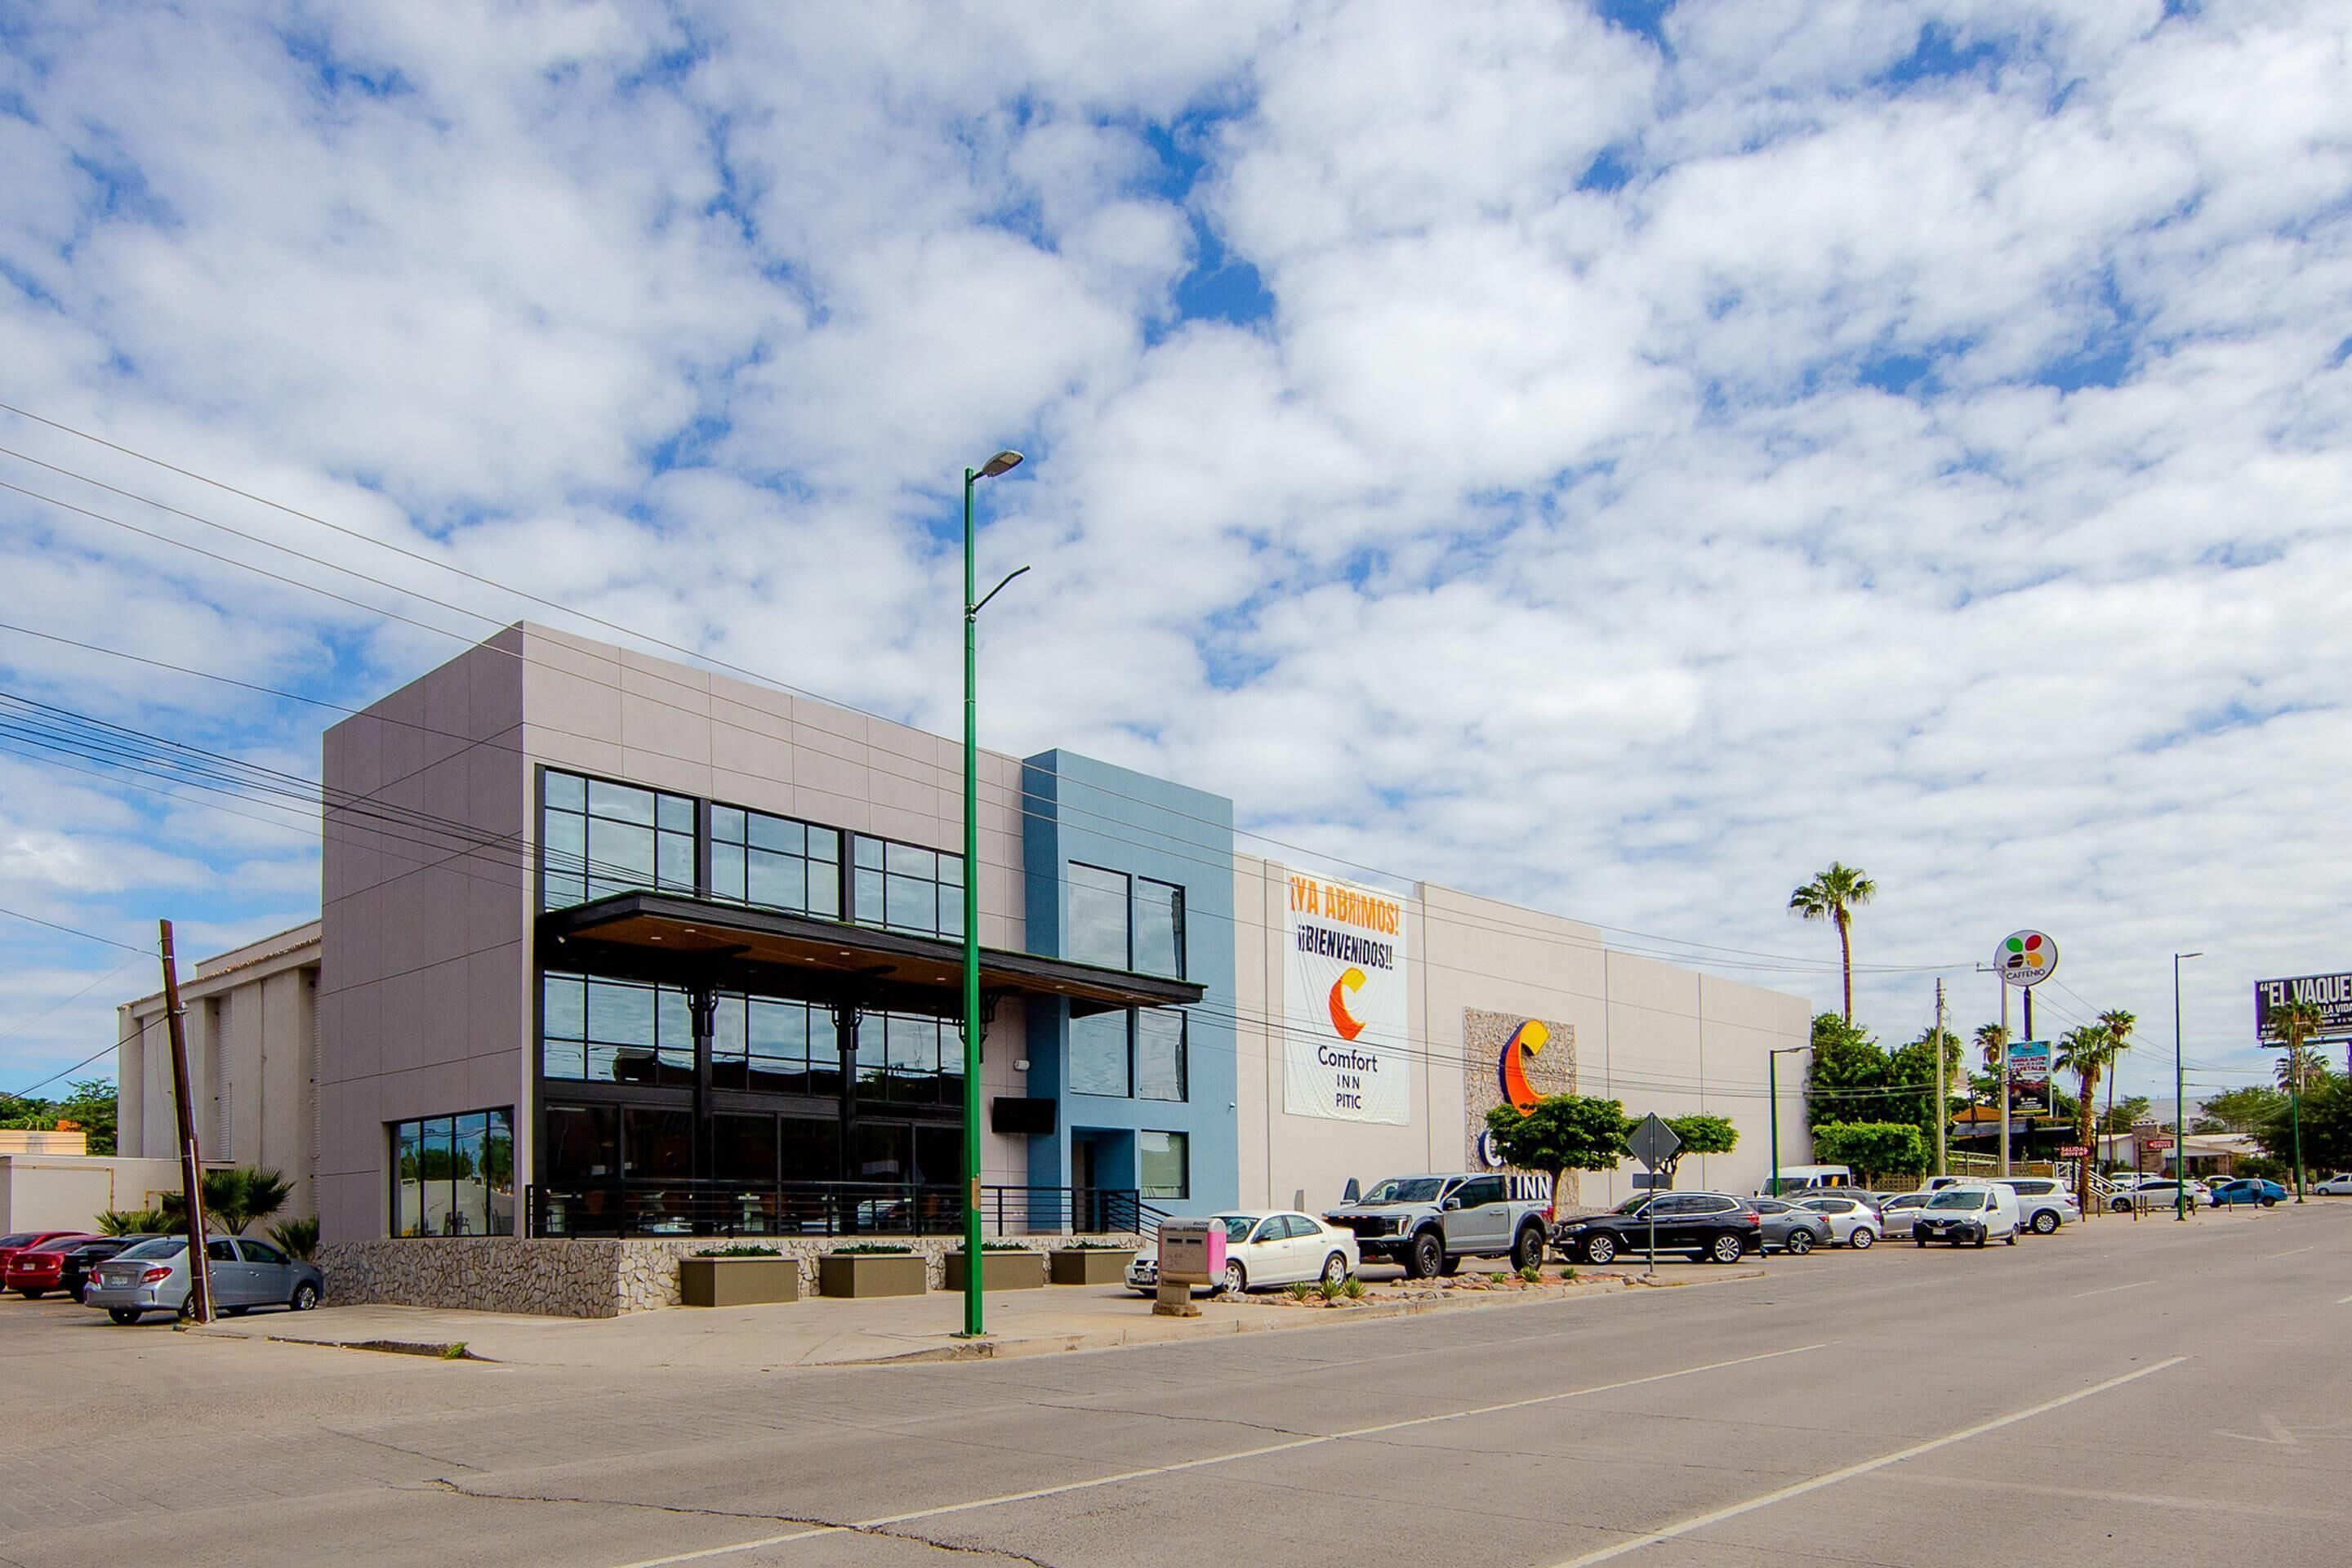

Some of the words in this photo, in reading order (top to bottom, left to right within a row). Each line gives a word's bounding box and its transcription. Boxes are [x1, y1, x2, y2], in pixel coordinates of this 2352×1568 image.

[1290, 877, 1319, 915] ¡YA
[1325, 886, 1400, 936] ABRIMOS!
[1298, 925, 1393, 970] ¡¡BIENVENIDOS!!
[2006, 969, 2046, 980] CAFFENIO
[2292, 976, 2352, 1004] VAQUE
[1317, 1045, 1379, 1073] Comfort
[1337, 1074, 1360, 1090] INN
[1336, 1093, 1361, 1110] PITIC
[1513, 1176, 1550, 1200] INN
